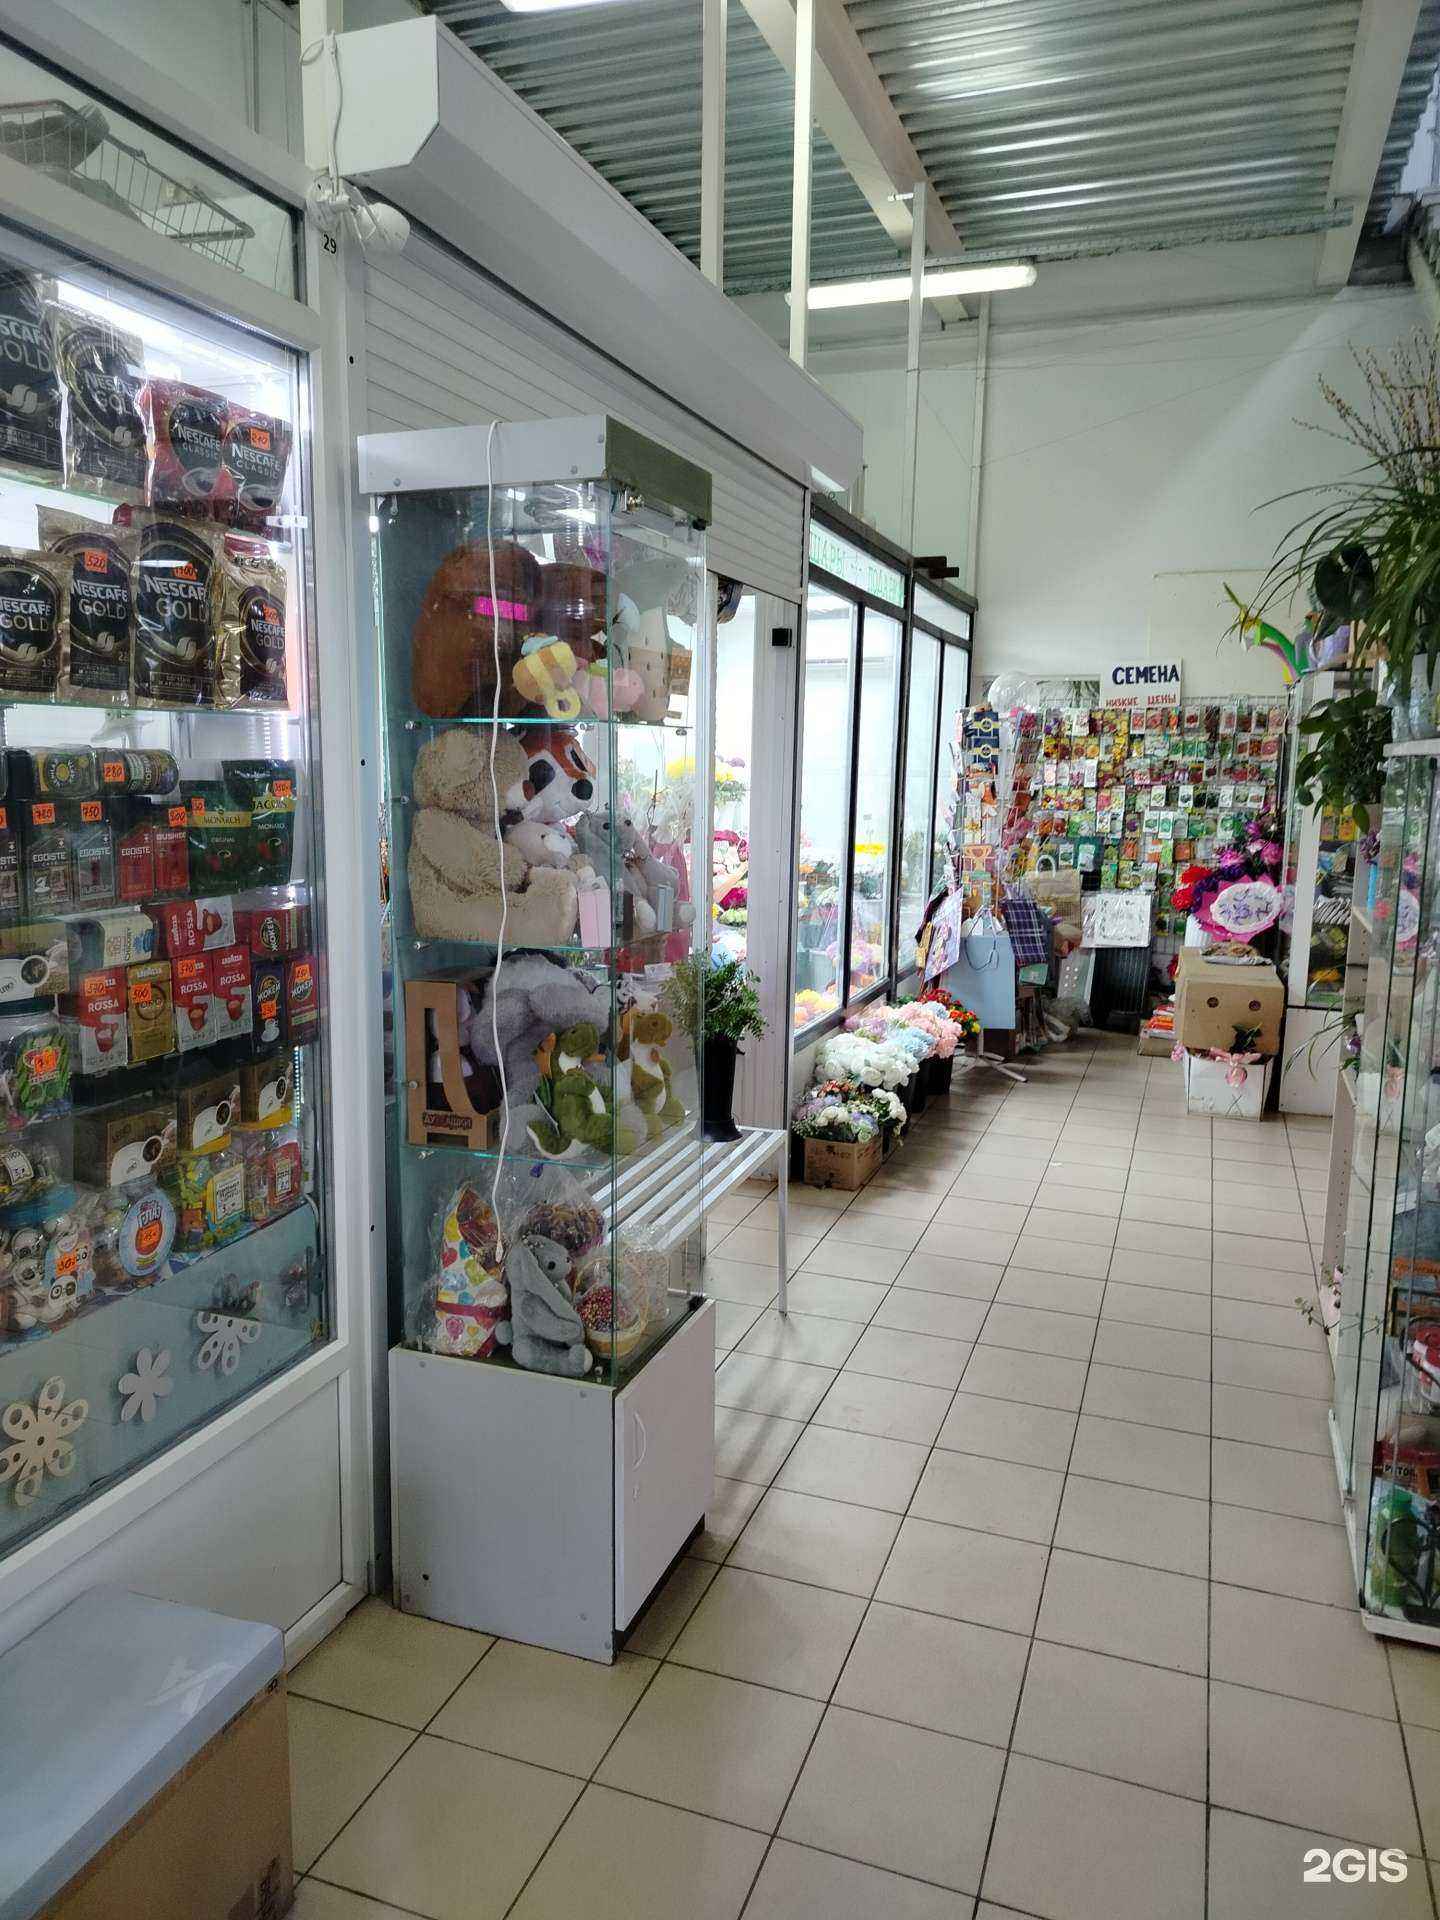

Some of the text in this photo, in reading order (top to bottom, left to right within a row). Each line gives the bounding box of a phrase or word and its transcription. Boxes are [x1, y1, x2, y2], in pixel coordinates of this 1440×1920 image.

[323, 233, 337, 254] 29
[79, 598, 127, 620] GOLD
[1112, 664, 1180, 685] СЕМЕНА
[1147, 693, 1177, 706] ЦЕНЫ
[88, 999, 119, 1013] ROSSA
